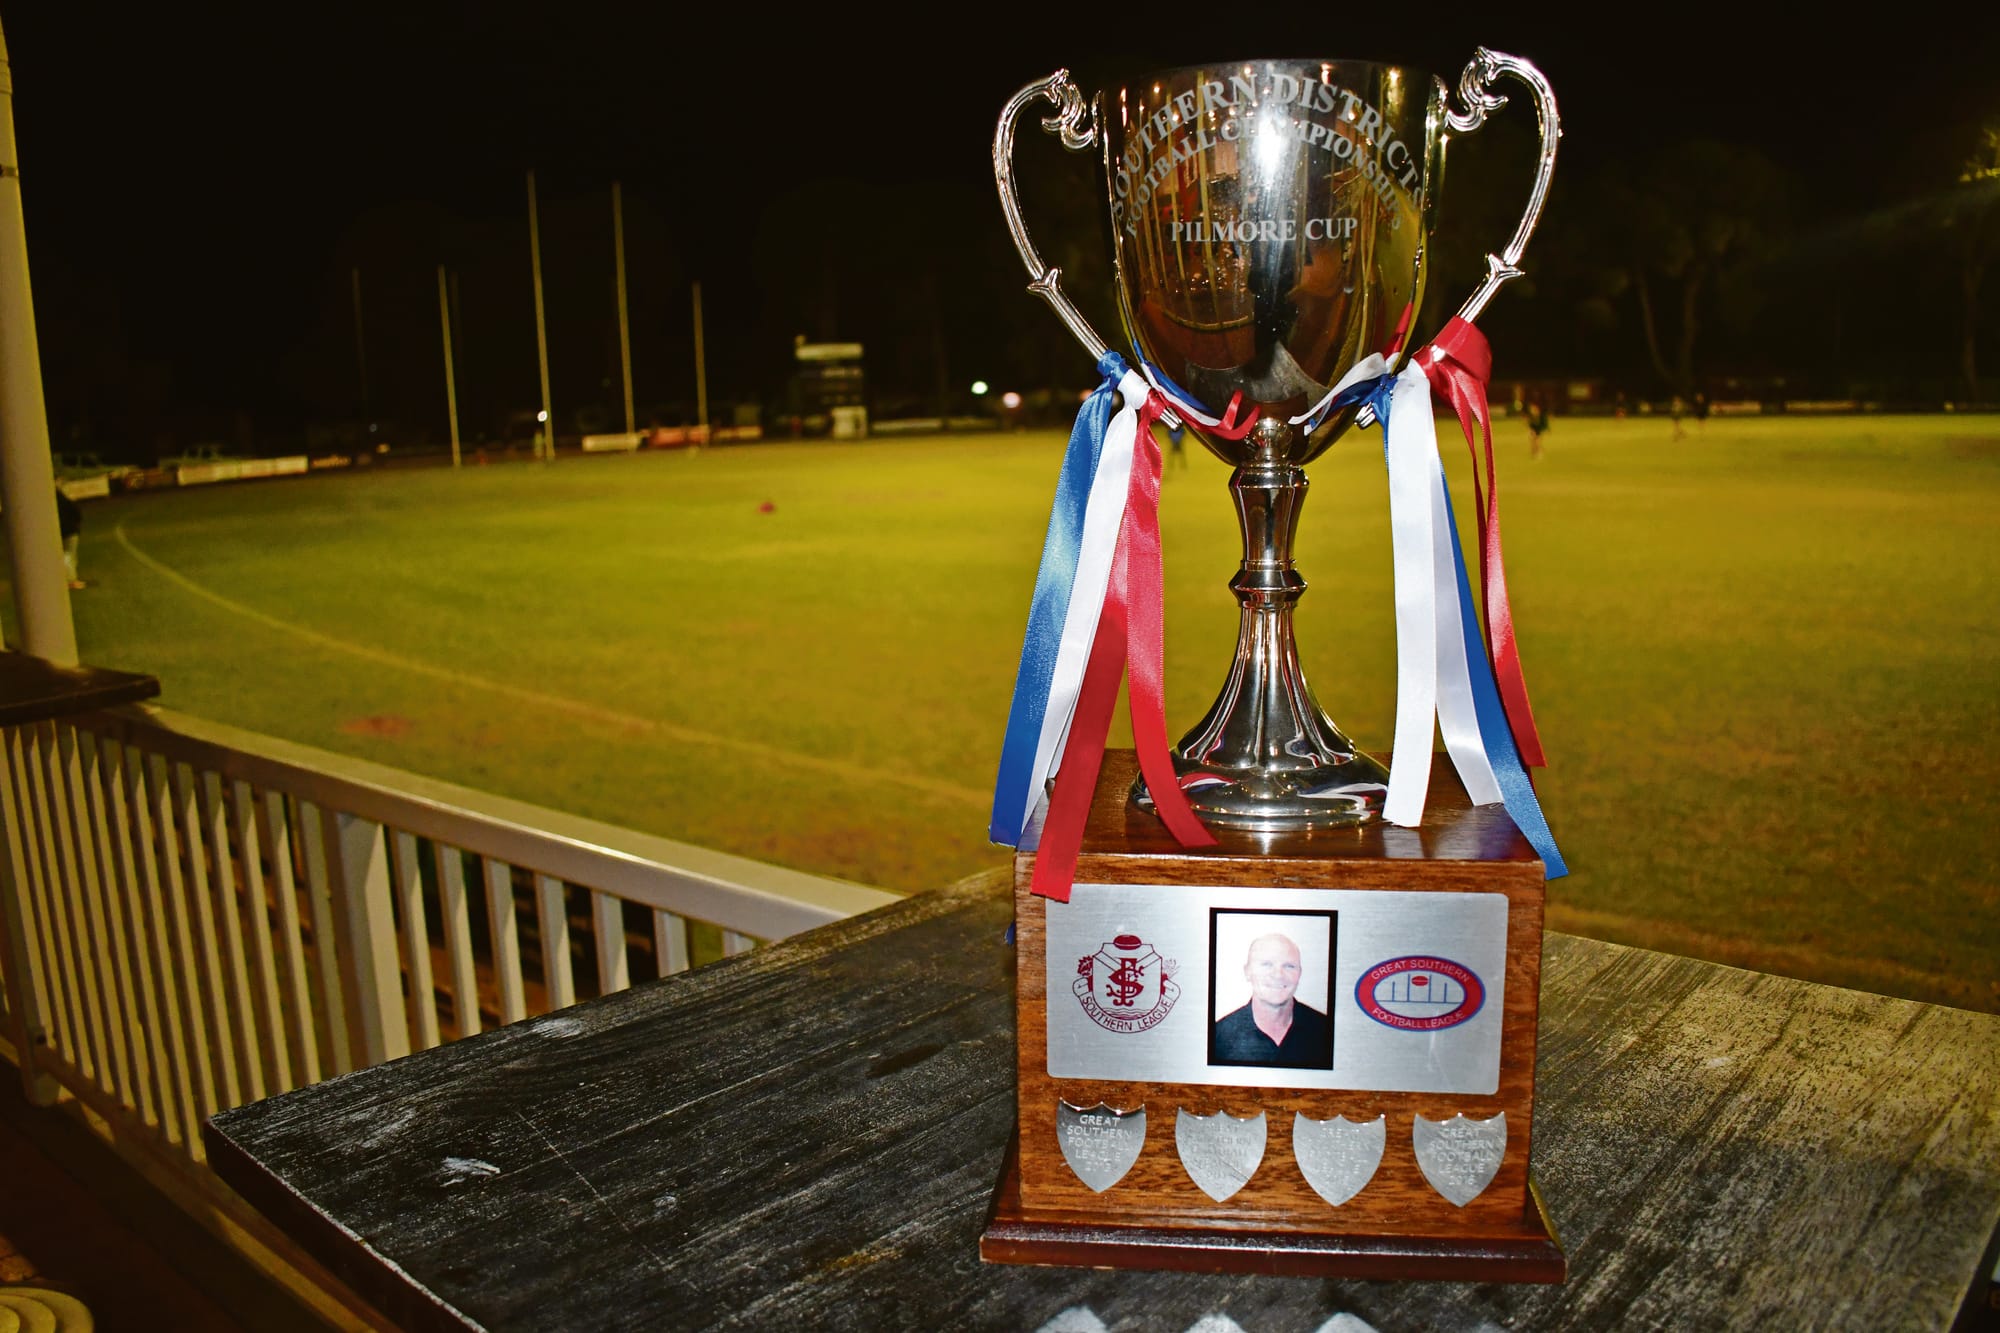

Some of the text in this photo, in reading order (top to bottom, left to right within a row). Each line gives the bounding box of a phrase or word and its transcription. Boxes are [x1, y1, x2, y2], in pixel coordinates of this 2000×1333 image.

[1111, 74, 1422, 221] SOUTHERN DISTRICTS
[1125, 117, 1403, 239] FOOTBALL CHMPIONSHIPS
[1170, 217, 1358, 243] PILMORE CUP
[1371, 959, 1470, 983] GREAT SOUTHERN
[1082, 995, 1172, 1032] SOUTHERN LEAGUE
[1372, 1007, 1464, 1029] FOOTBALL LEAGUE
[1079, 1114, 1121, 1127] GREAT
[1066, 1125, 1133, 1139] SOUTHERN
[1439, 1127, 1480, 1139] GREAT
[1429, 1139, 1494, 1151] SOUTHERN
[1439, 1162, 1486, 1174] LEAGUE
